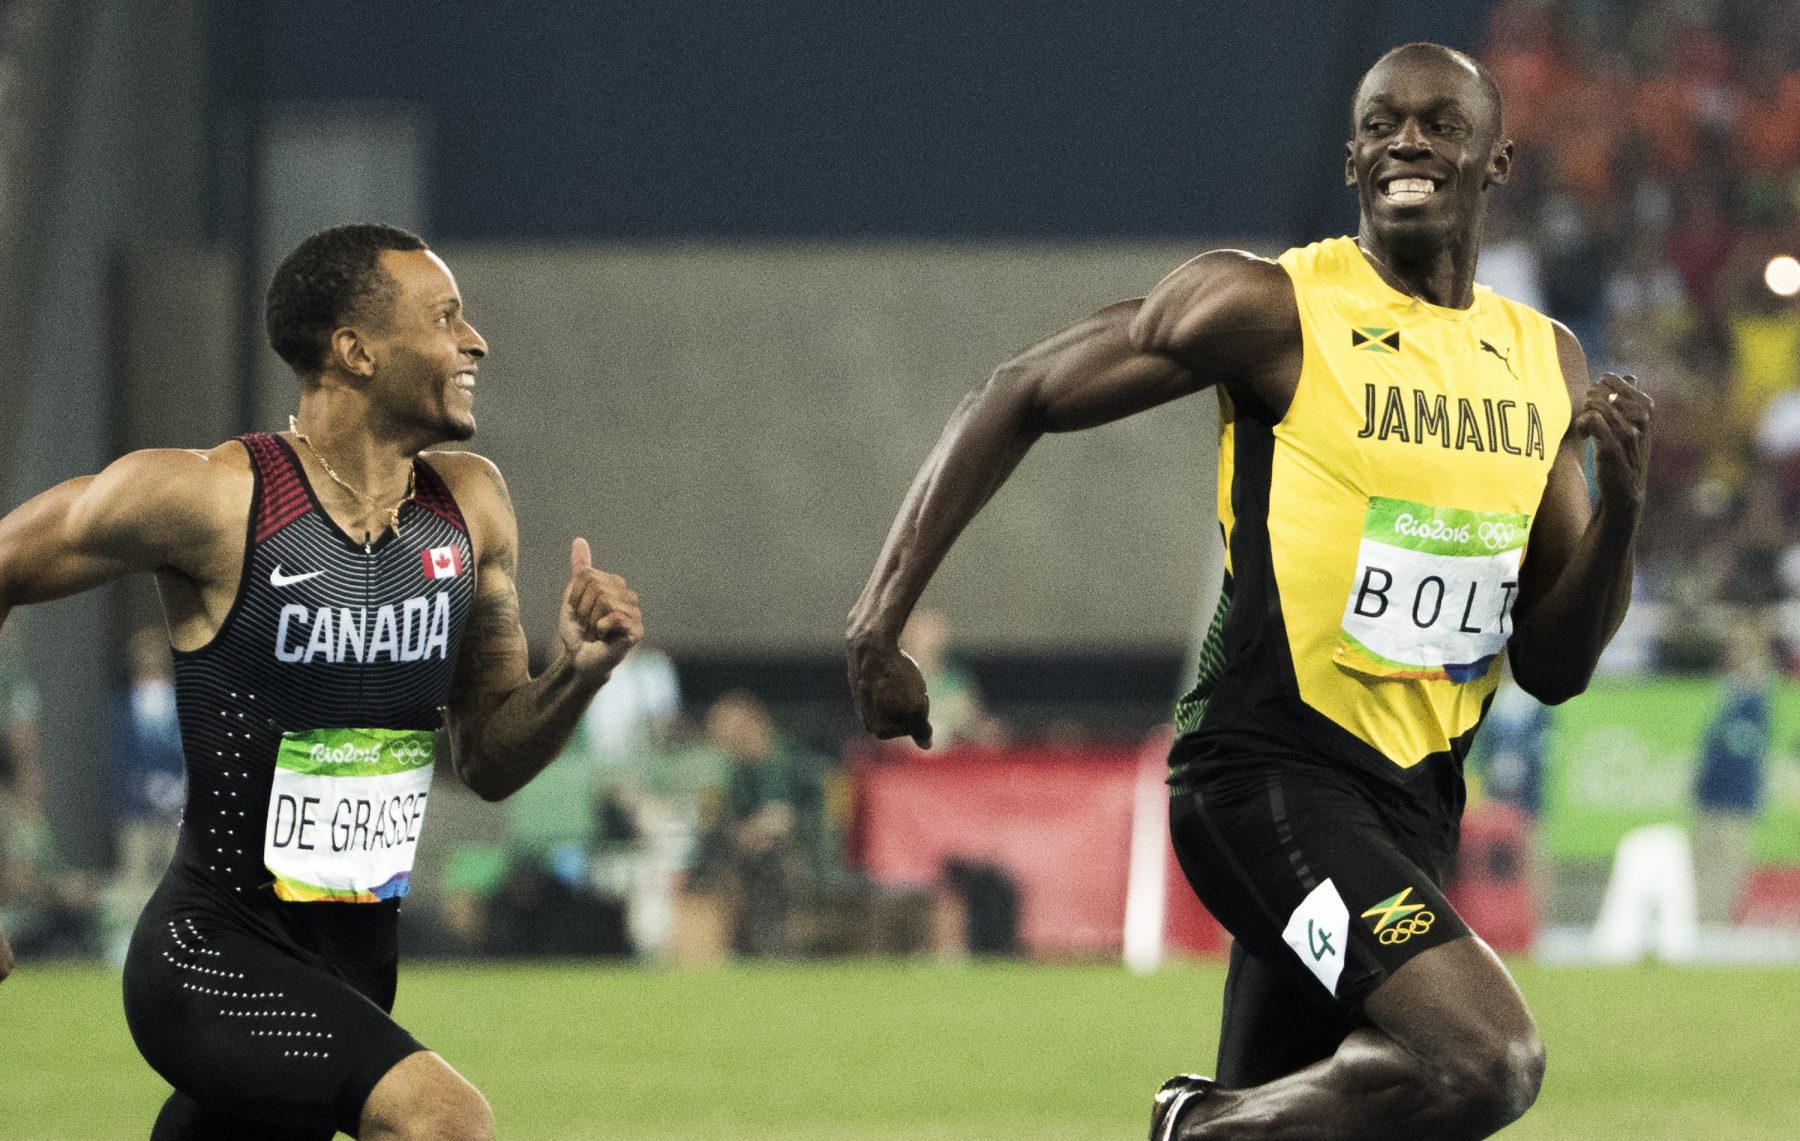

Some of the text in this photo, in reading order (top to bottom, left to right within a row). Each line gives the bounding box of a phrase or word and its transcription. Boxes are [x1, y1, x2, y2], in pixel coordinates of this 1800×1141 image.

[1357, 383, 1545, 461] JAMAICA
[274, 591, 450, 664] CANADA
[1353, 565, 1518, 634] BOLT
[273, 791, 428, 852] DE GRASSE
[1307, 918, 1337, 962] 4
